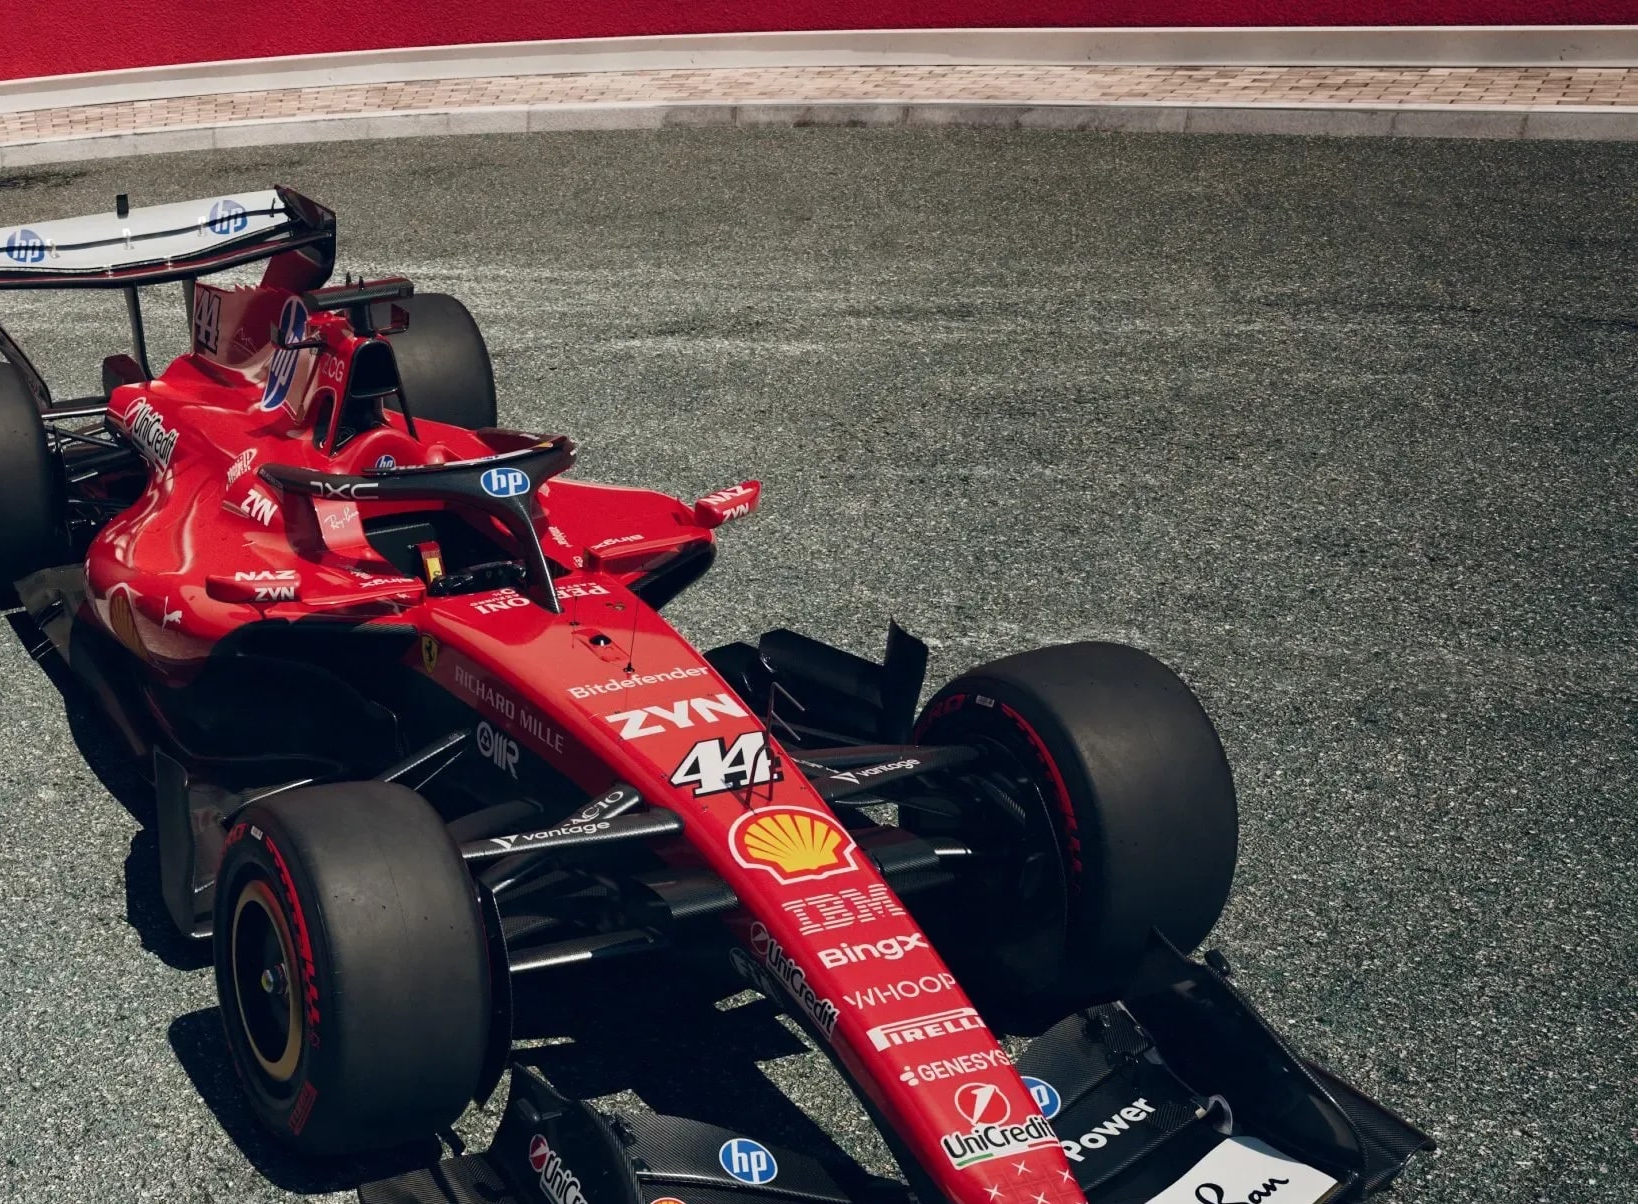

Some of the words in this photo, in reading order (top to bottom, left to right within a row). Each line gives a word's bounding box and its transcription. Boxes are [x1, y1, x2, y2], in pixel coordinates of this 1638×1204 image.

[210, 199, 248, 235] hp
[6, 229, 46, 263] hp
[134, 405, 179, 466] UniCredit
[481, 468, 530, 497] hp
[703, 485, 753, 506] ZYN
[241, 488, 279, 527] ZYN
[324, 506, 360, 530] Ray-Ban
[234, 569, 296, 582] ZYN
[255, 586, 295, 601] ZYN
[567, 666, 710, 699] Bitdefender
[454, 665, 516, 720] RICHARD
[519, 709, 565, 755] MILLE
[604, 693, 749, 741] ZYN
[668, 730, 784, 798] 44
[856, 757, 922, 778] vantage
[522, 821, 611, 842] vantage
[782, 883, 907, 936] IBM
[767, 938, 840, 1035] UniCredit
[843, 972, 956, 1010] WHOOP
[866, 1007, 987, 1052] PIRELLI
[917, 1050, 1012, 1082] GENESYS
[942, 1116, 1057, 1160] UniCredit
[1061, 1097, 1156, 1162] Power
[720, 1138, 776, 1185] hp
